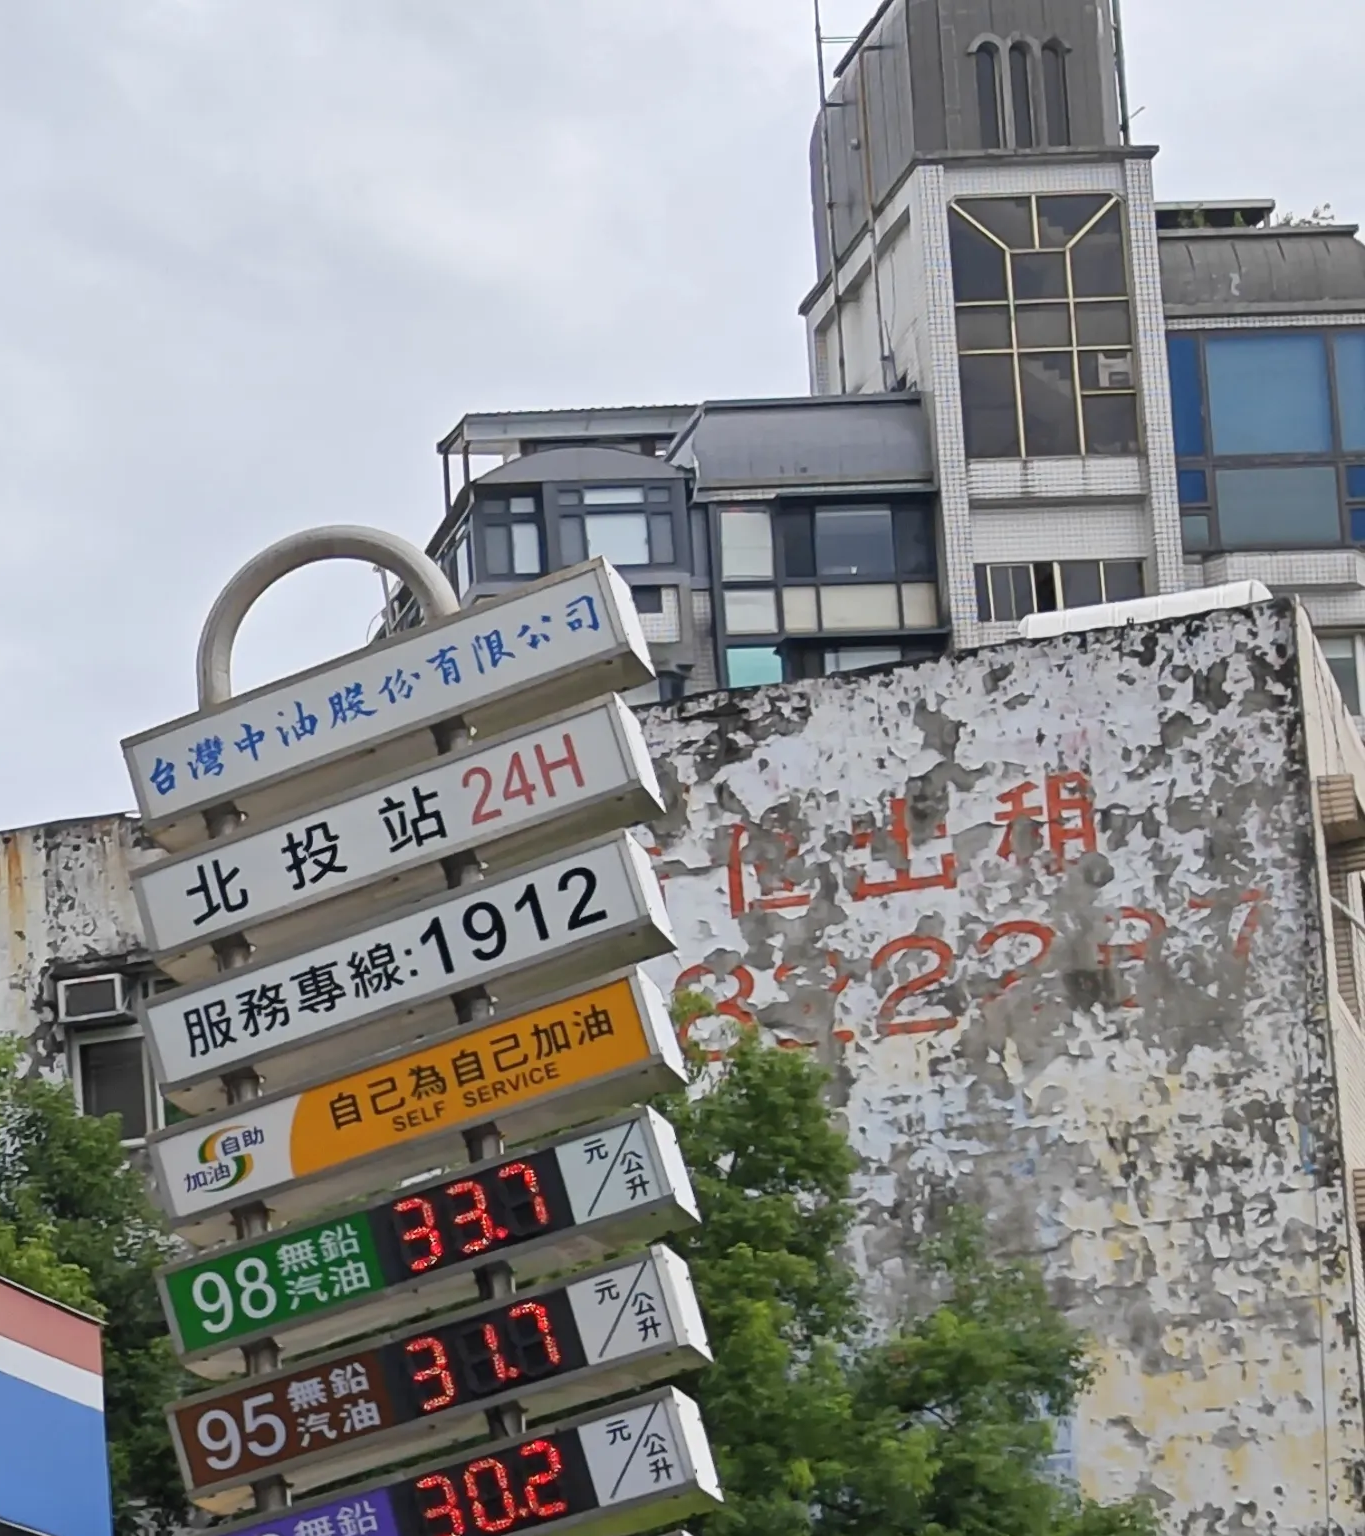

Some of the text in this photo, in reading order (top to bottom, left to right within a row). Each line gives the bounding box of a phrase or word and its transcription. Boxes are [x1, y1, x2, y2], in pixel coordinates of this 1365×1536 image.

[149, 594, 601, 796] 台灣中油股份有限公司
[186, 734, 586, 926] 北投站 24H
[328, 1004, 615, 1130] 自己為自己加油
[391, 1062, 561, 1134] SELF SERVICE
[183, 1162, 231, 1194] 加油
[220, 1126, 264, 1158] 自助
[276, 1227, 363, 1274] 無鉛
[392, 1162, 551, 1273] 33.7
[191, 1256, 278, 1335] 98
[284, 1260, 371, 1311] 汽油
[286, 1361, 370, 1412] 無鉛
[405, 1302, 561, 1413] 31.7
[195, 1394, 287, 1471] 95
[296, 1399, 382, 1448] 汽油
